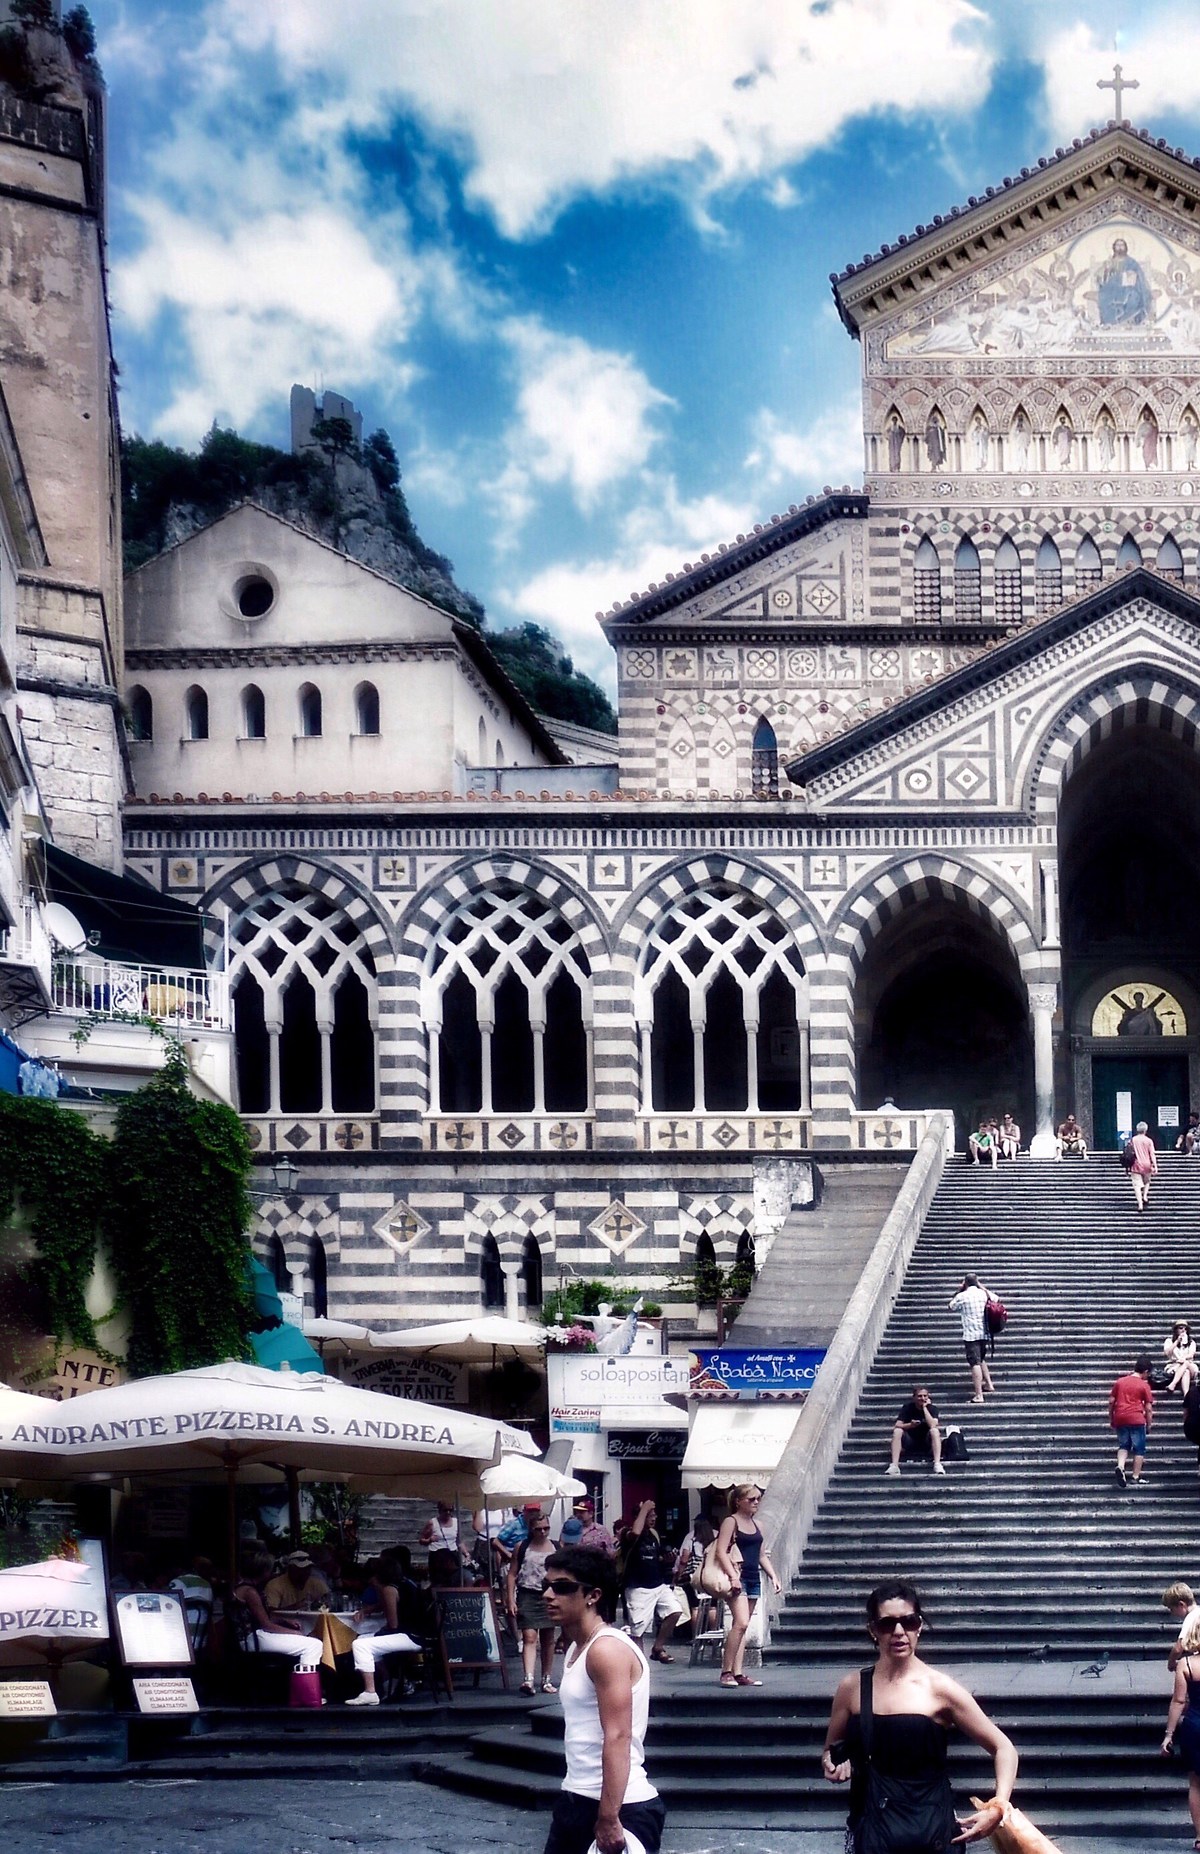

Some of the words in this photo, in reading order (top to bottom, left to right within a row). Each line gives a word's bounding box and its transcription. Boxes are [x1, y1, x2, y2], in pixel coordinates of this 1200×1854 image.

[351, 1358, 396, 1382] TAVERNA
[410, 1360, 458, 1384] APOSTOLI
[720, 1361, 767, 1379] Babà
[551, 1407, 571, 1416] Hair
[571, 1407, 601, 1417] Zarino
[11, 1416, 169, 1445] ANDRANTE
[174, 1410, 305, 1434] PIZZERIA
[311, 1416, 336, 1435] S.
[343, 1418, 456, 1446] ANDREA
[607, 1439, 652, 1458] Bijoux
